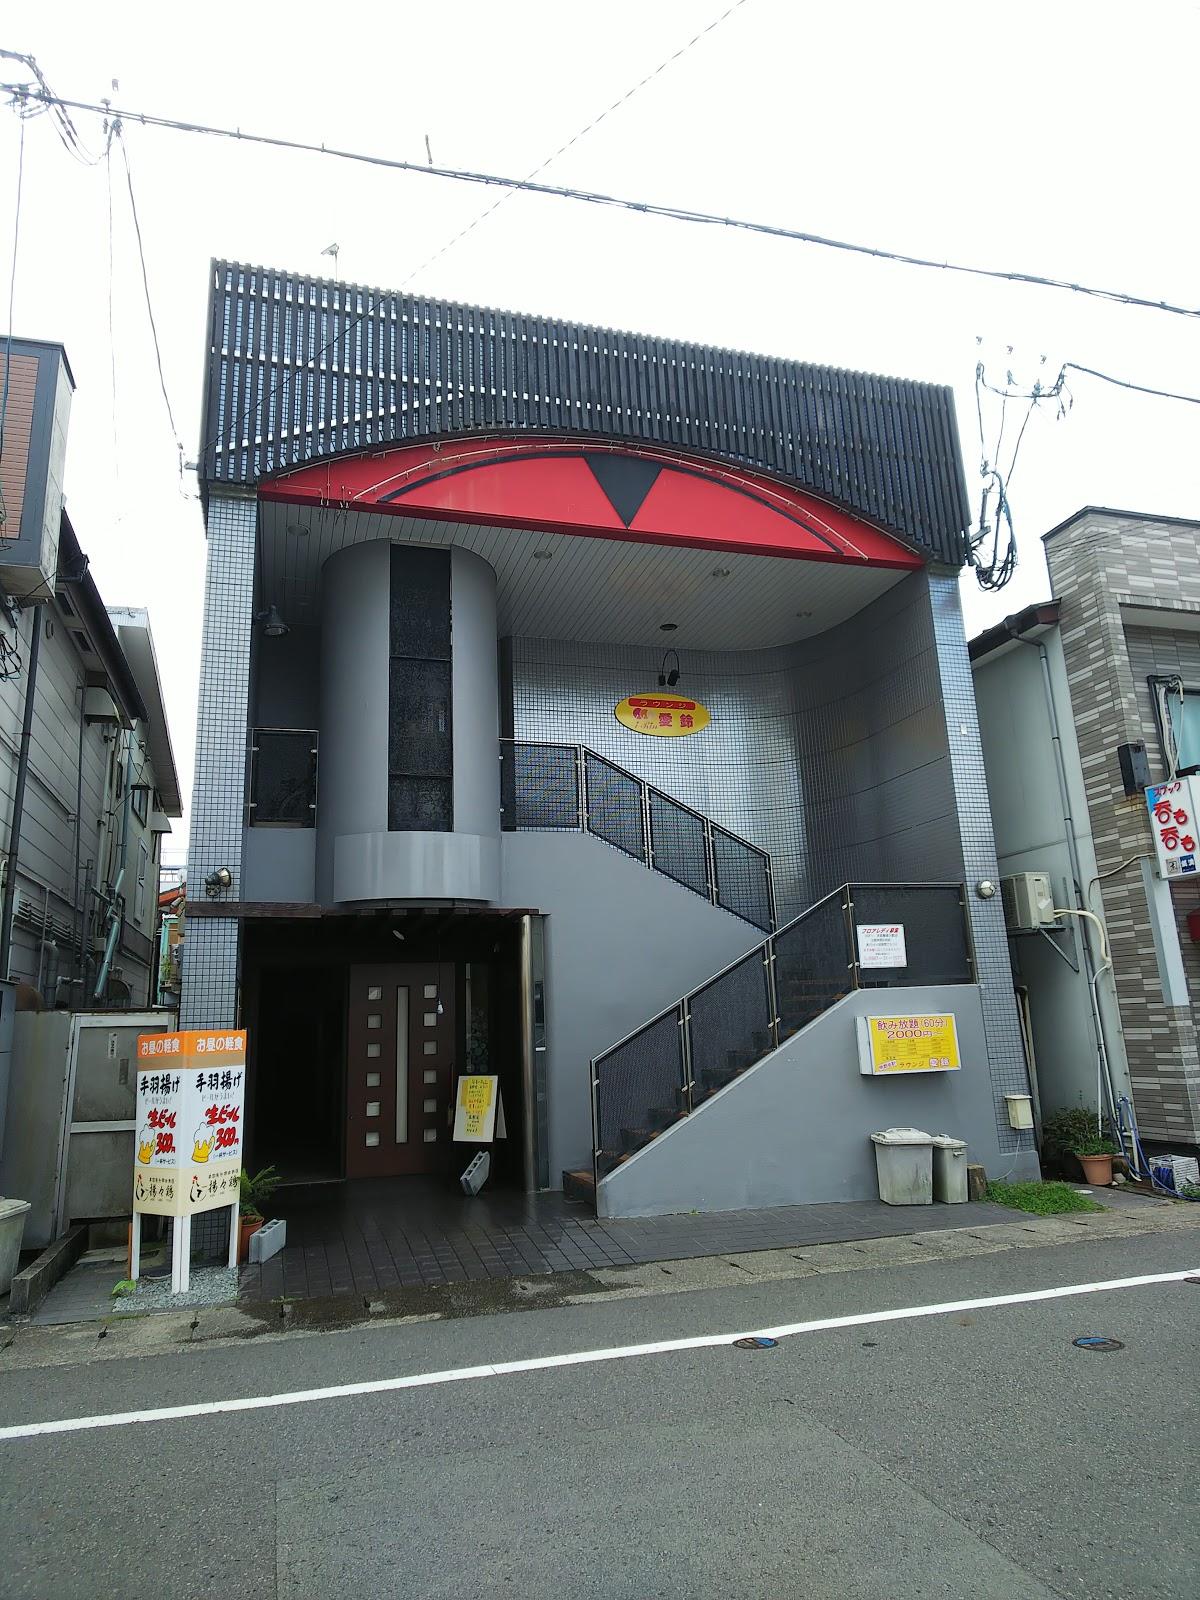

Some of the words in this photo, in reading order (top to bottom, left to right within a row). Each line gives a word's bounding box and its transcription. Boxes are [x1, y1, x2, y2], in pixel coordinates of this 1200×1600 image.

[640, 701, 686, 709] ラウンジ
[1153, 782, 1182, 797] スナック
[141, 1037, 180, 1056] お昼の軽食
[196, 1036, 244, 1053] お昼の軽食
[140, 1073, 181, 1097] 手羽揚げ
[195, 1069, 244, 1093] 手羽揚げ
